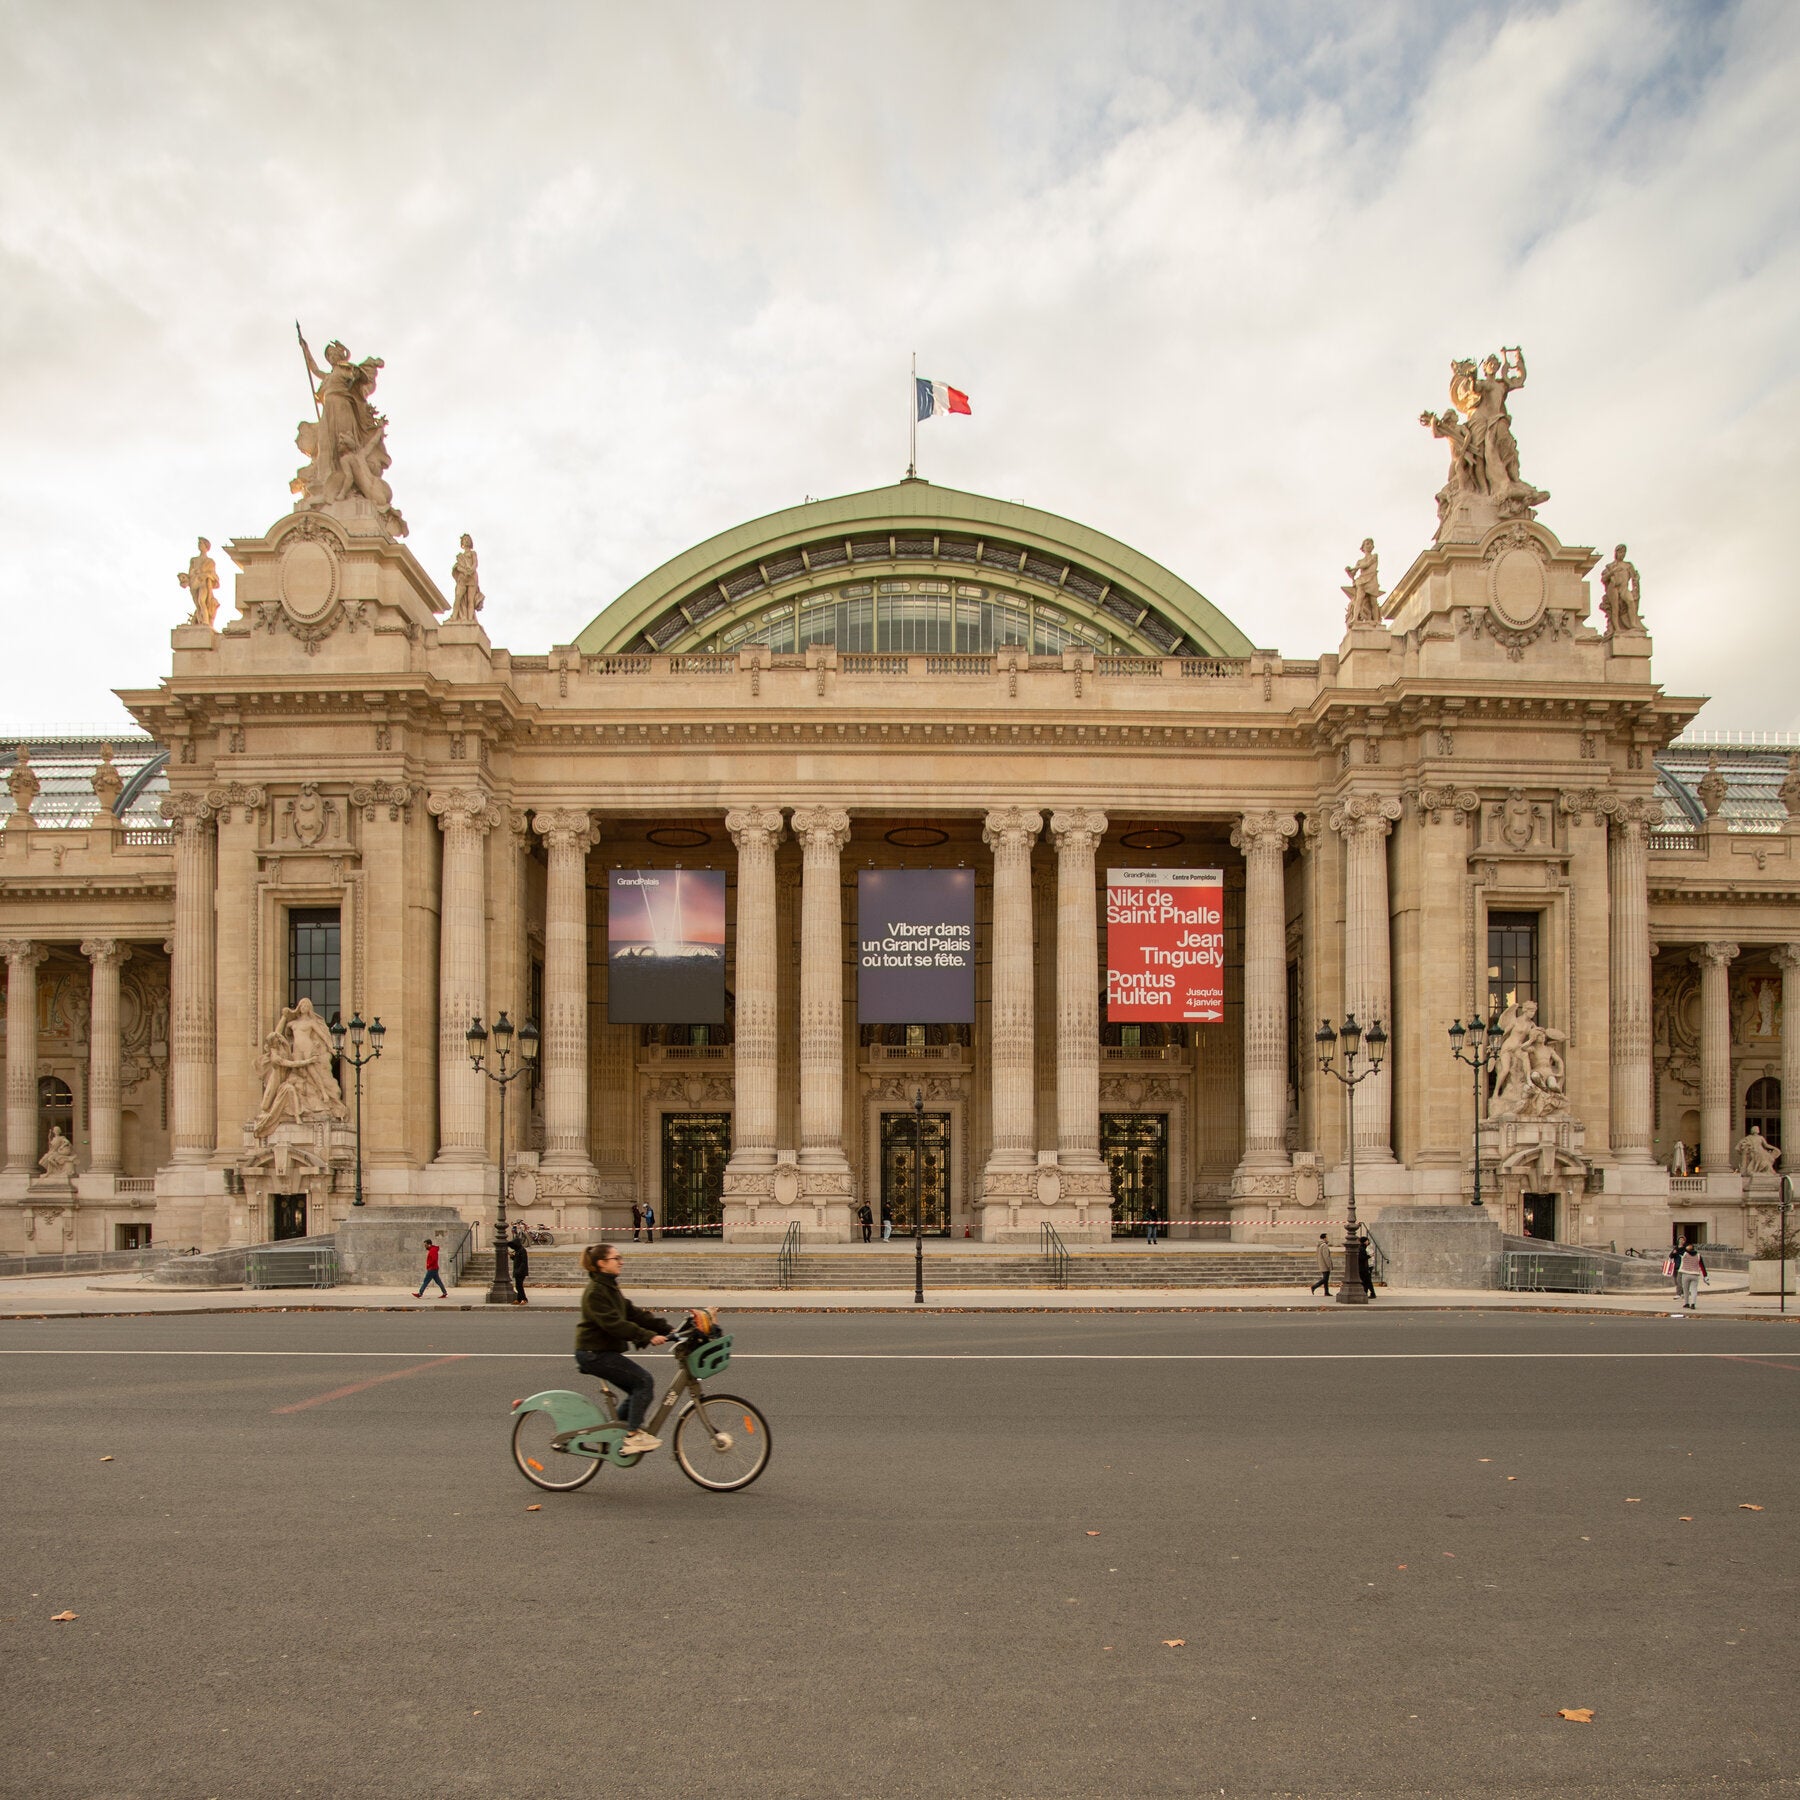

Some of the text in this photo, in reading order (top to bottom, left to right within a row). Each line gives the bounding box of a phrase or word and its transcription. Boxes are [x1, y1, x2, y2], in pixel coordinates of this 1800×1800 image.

[617, 877, 660, 886] GrandPalais
[1190, 874, 1217, 882] Pompidou
[1107, 889, 1173, 907] Niki de
[1107, 906, 1221, 924] Saint Phalle
[887, 922, 971, 936] Vibrer dans
[862, 937, 971, 952] un Grand Palais
[1176, 929, 1224, 948] Jean
[862, 953, 966, 967] où tout se fête.
[1139, 947, 1224, 968] Tinguely
[1107, 969, 1176, 988] Pontus
[1107, 987, 1171, 1005] Hulten
[1186, 988, 1224, 997] Jusqu'au
[1186, 998, 1222, 1008] 4 janvier
